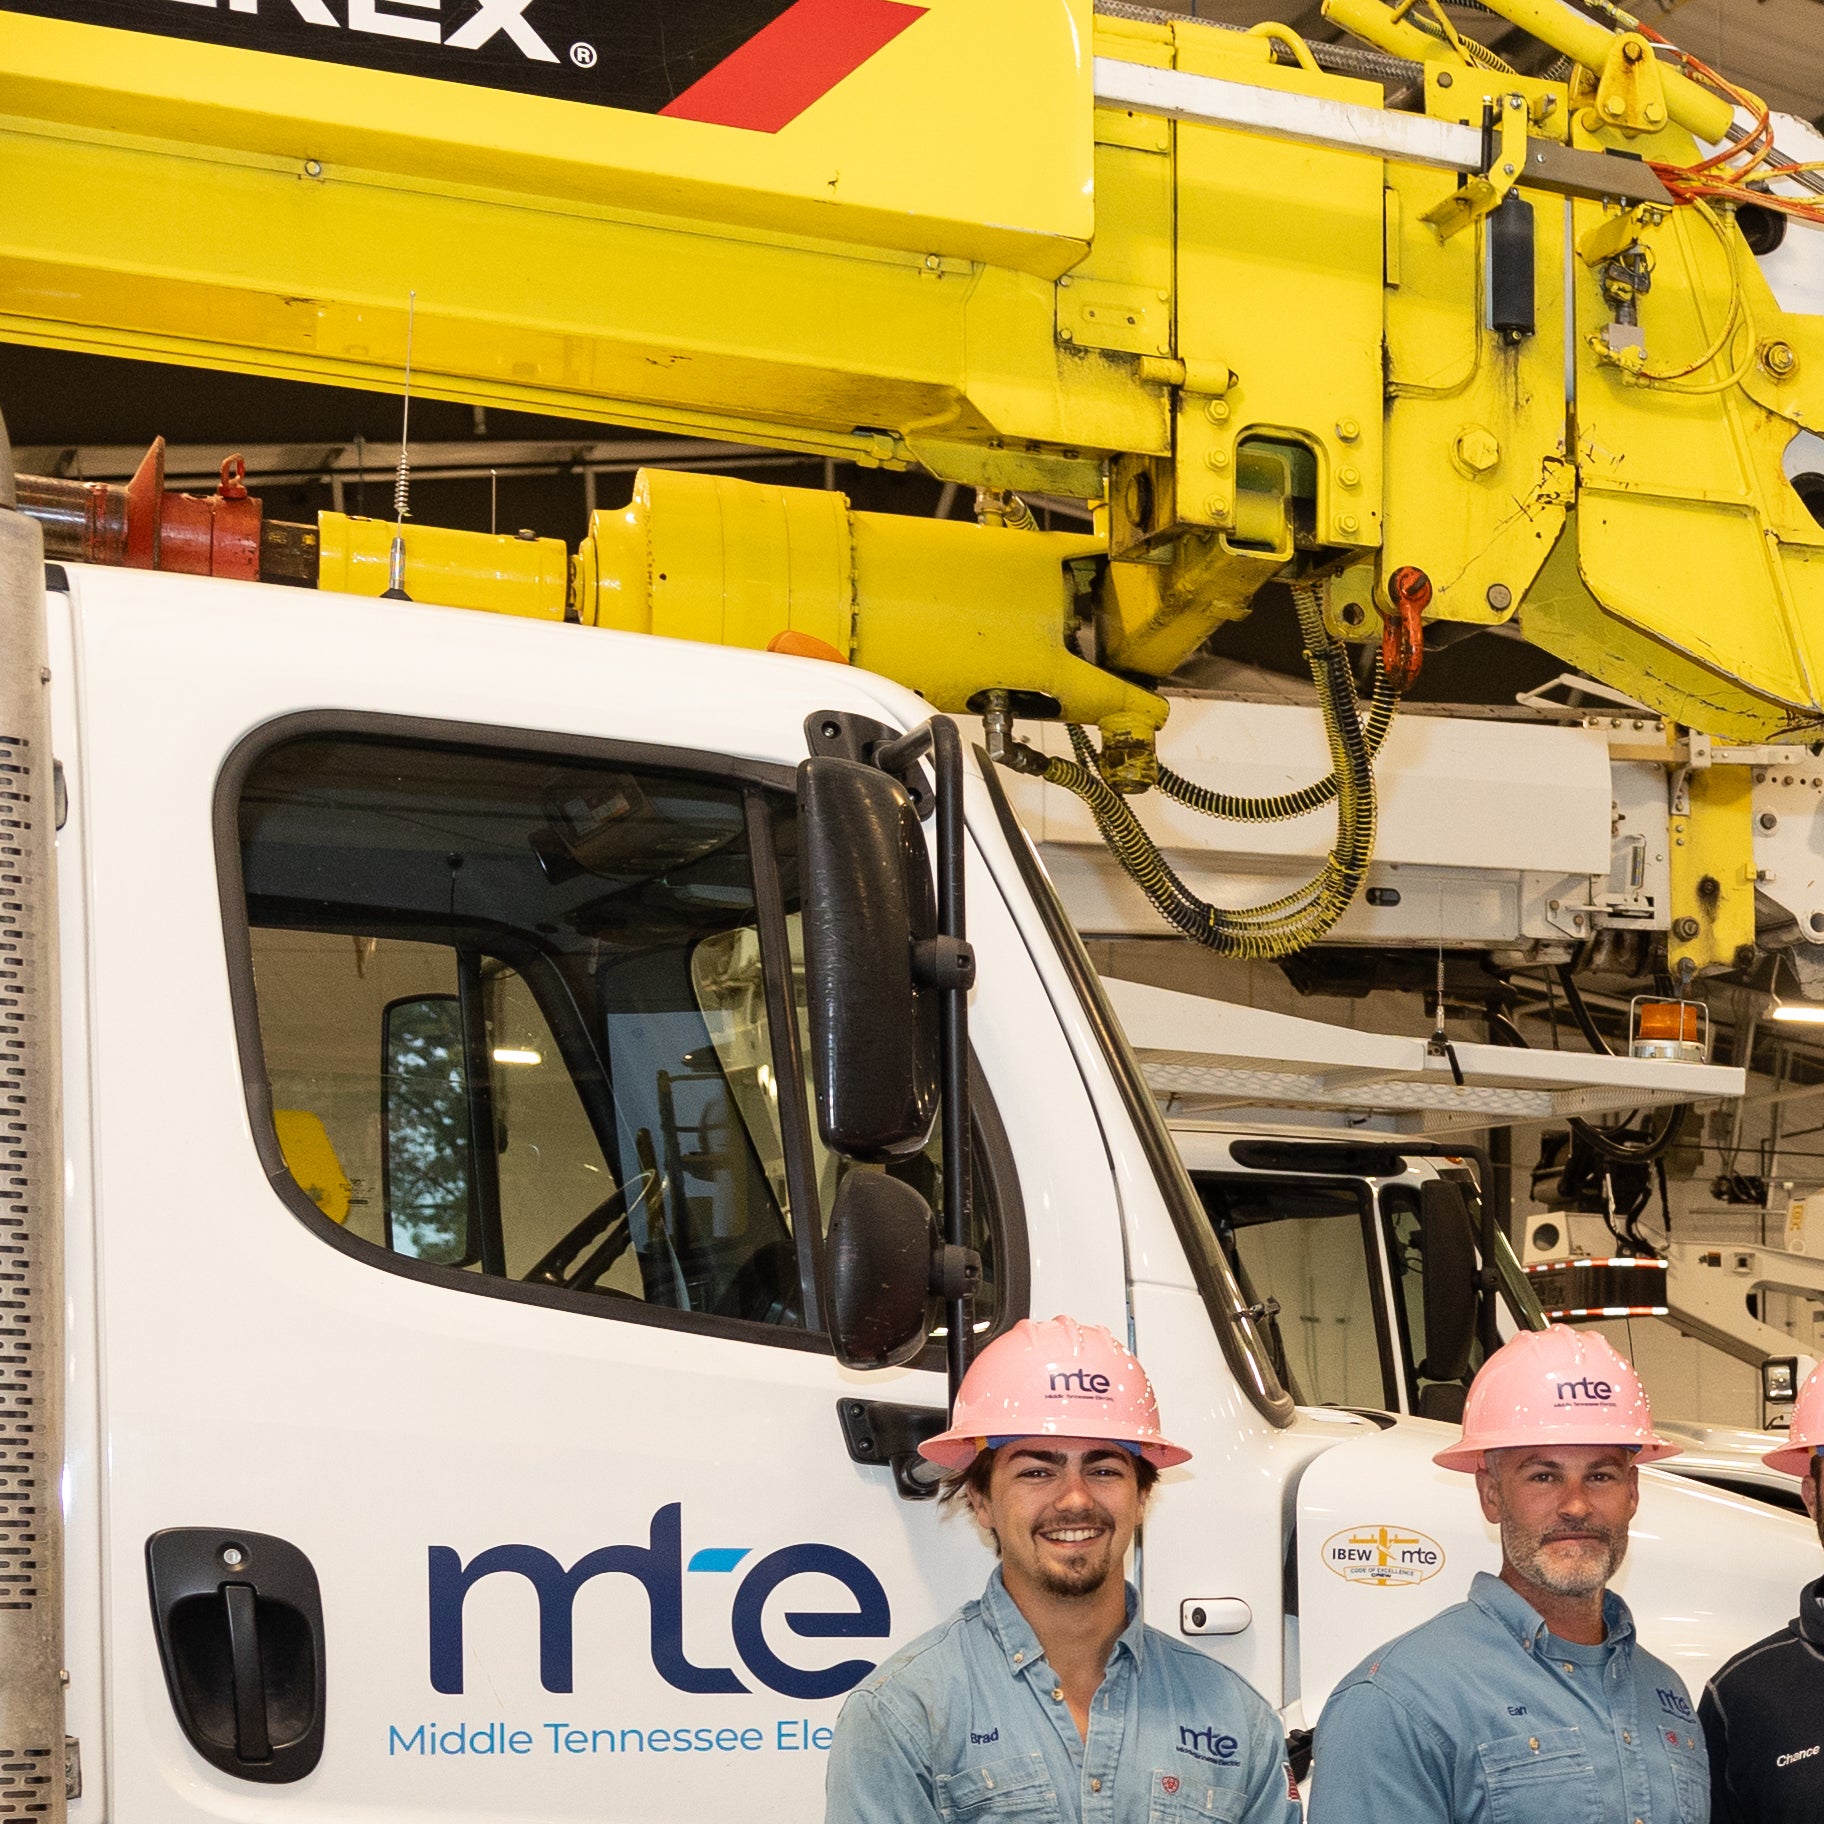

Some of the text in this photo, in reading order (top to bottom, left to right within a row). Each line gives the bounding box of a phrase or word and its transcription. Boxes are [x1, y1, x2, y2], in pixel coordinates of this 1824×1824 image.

[1049, 1368, 1111, 1394] mte
[1556, 1376, 1613, 1400] mte
[1332, 1548, 1372, 1561] IBEW
[1401, 1547, 1438, 1565] mte
[428, 1501, 891, 1700] mte
[388, 1721, 533, 1756] Middle
[543, 1722, 763, 1754] Tennessee
[970, 1727, 999, 1745] Brad
[1179, 1725, 1239, 1759] mte
[1776, 1745, 1821, 1768] Chance
